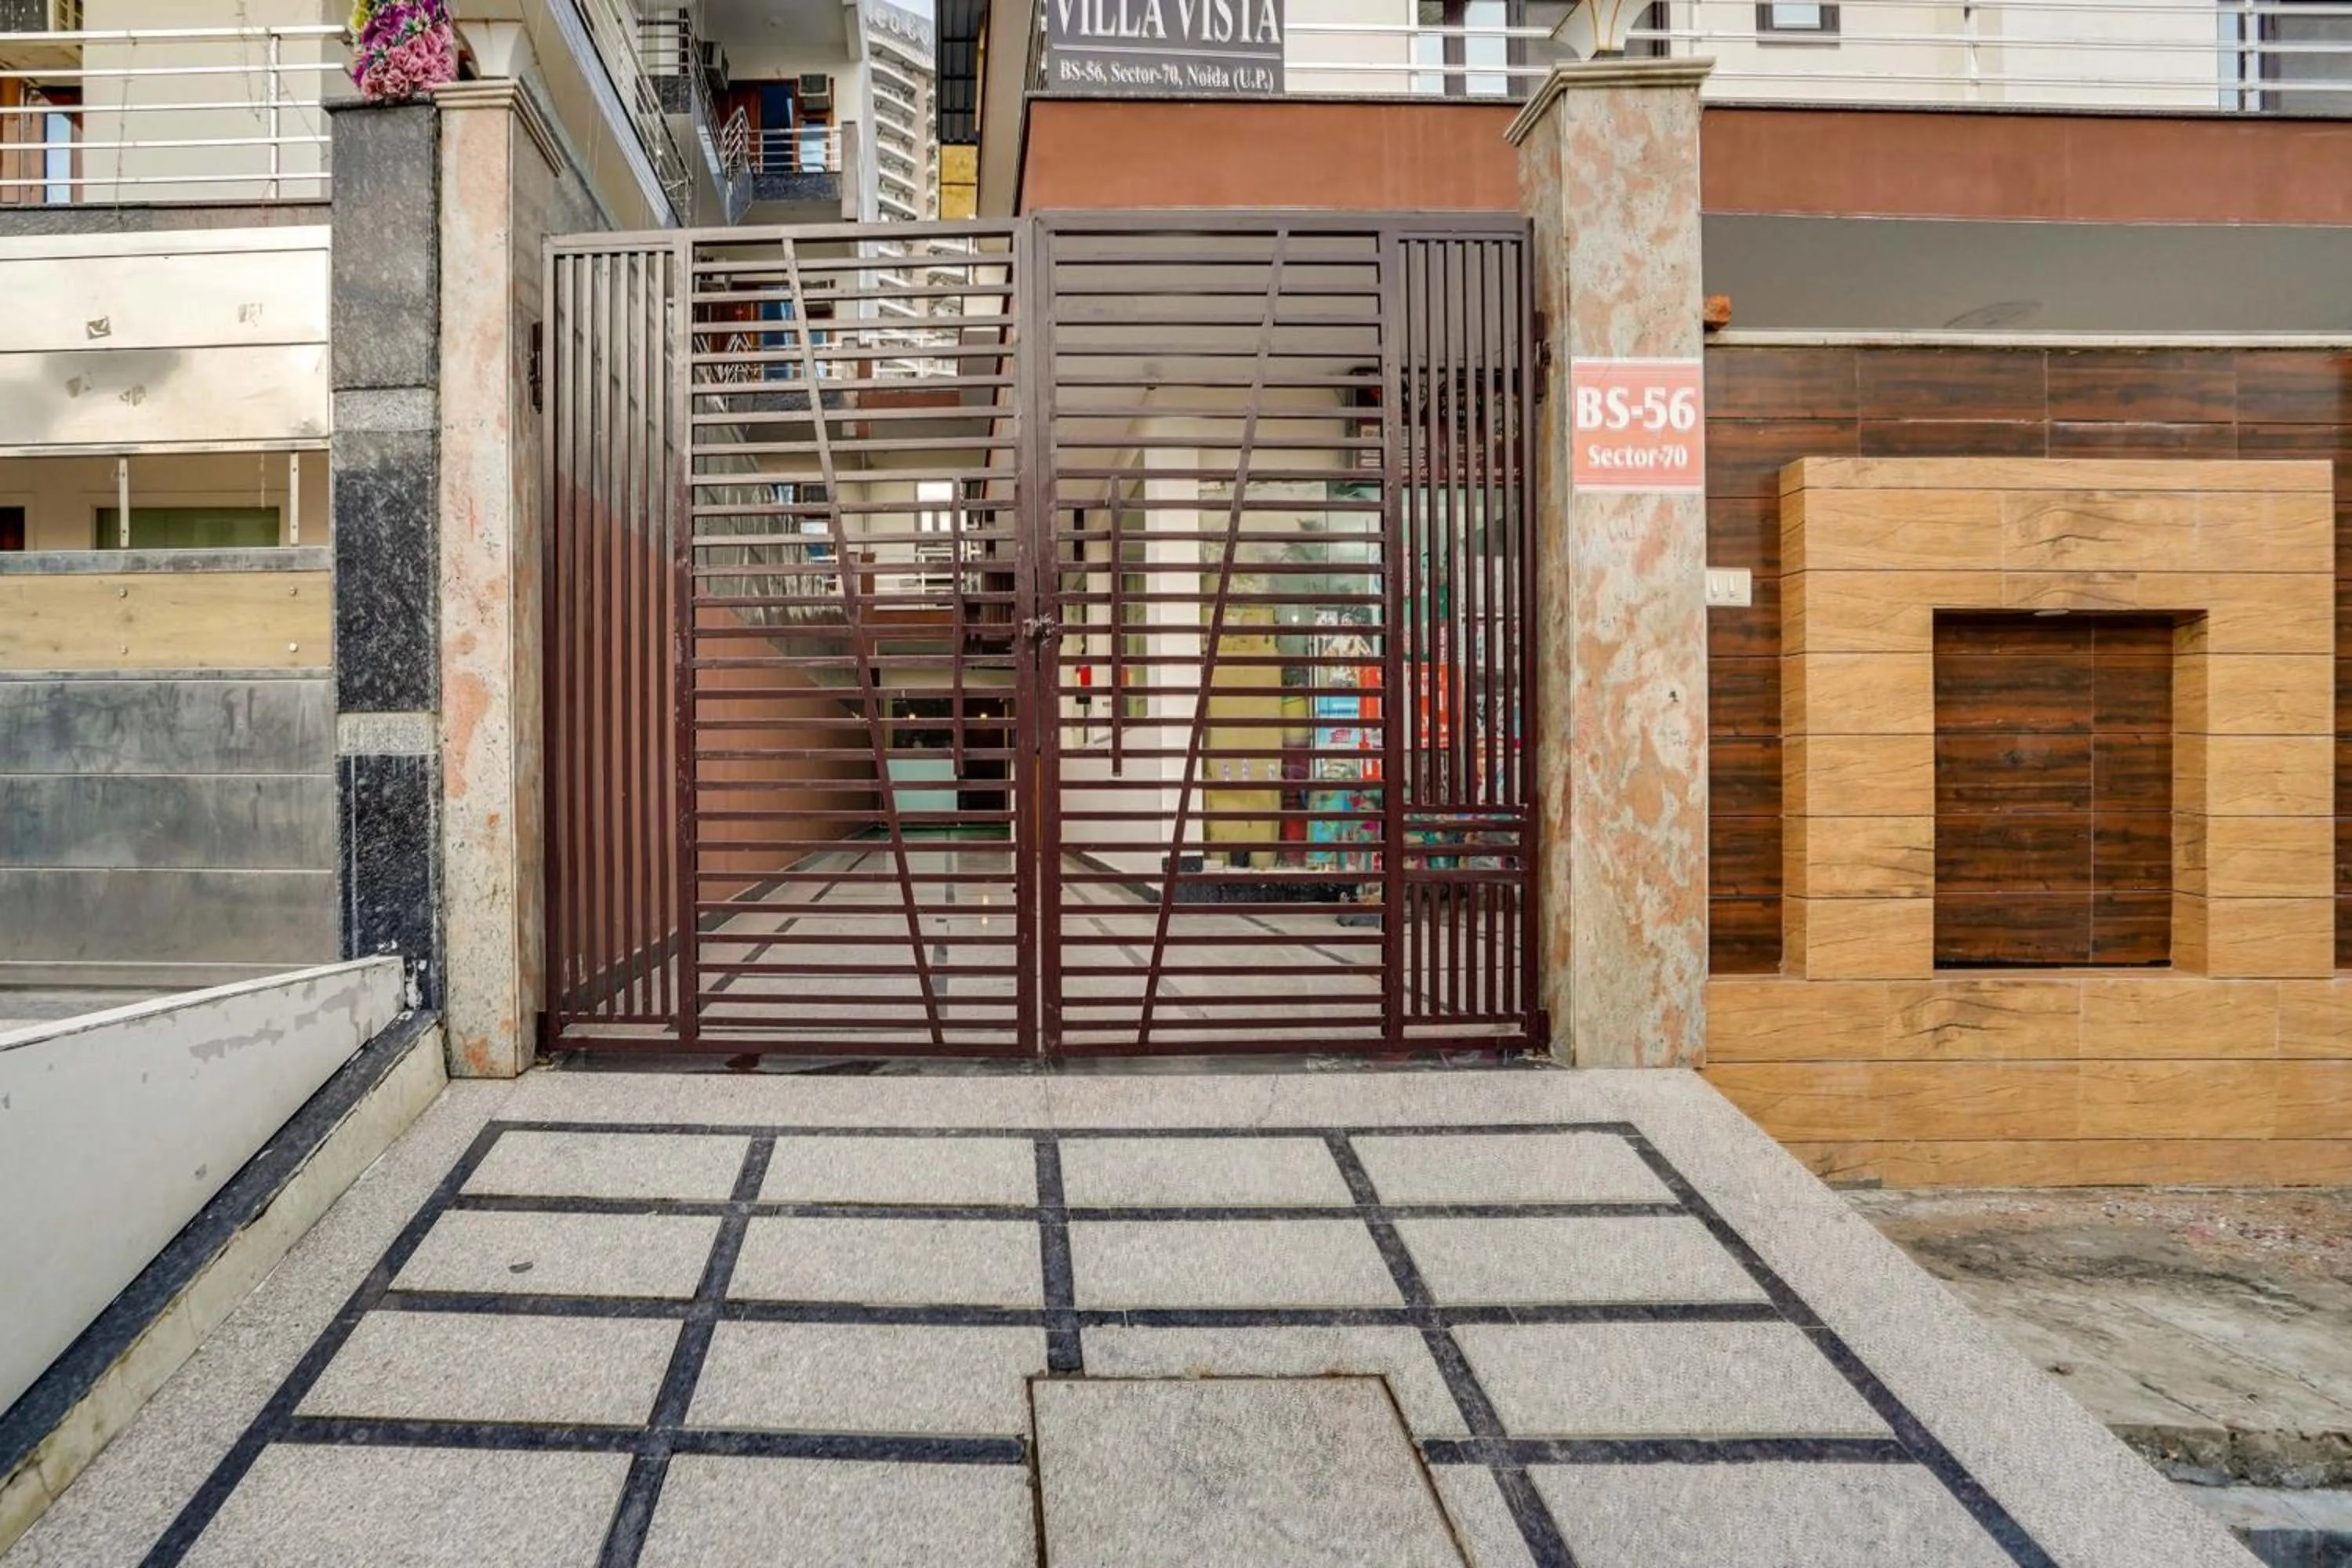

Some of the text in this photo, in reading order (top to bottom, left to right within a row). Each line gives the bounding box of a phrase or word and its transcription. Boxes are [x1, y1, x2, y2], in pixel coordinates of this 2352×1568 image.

[1055, 0, 1282, 44] VILLA VISTA
[1060, 59, 1274, 94] BS-56, Sector-70, Noida (U.P.)
[1577, 387, 1696, 430] BS-56
